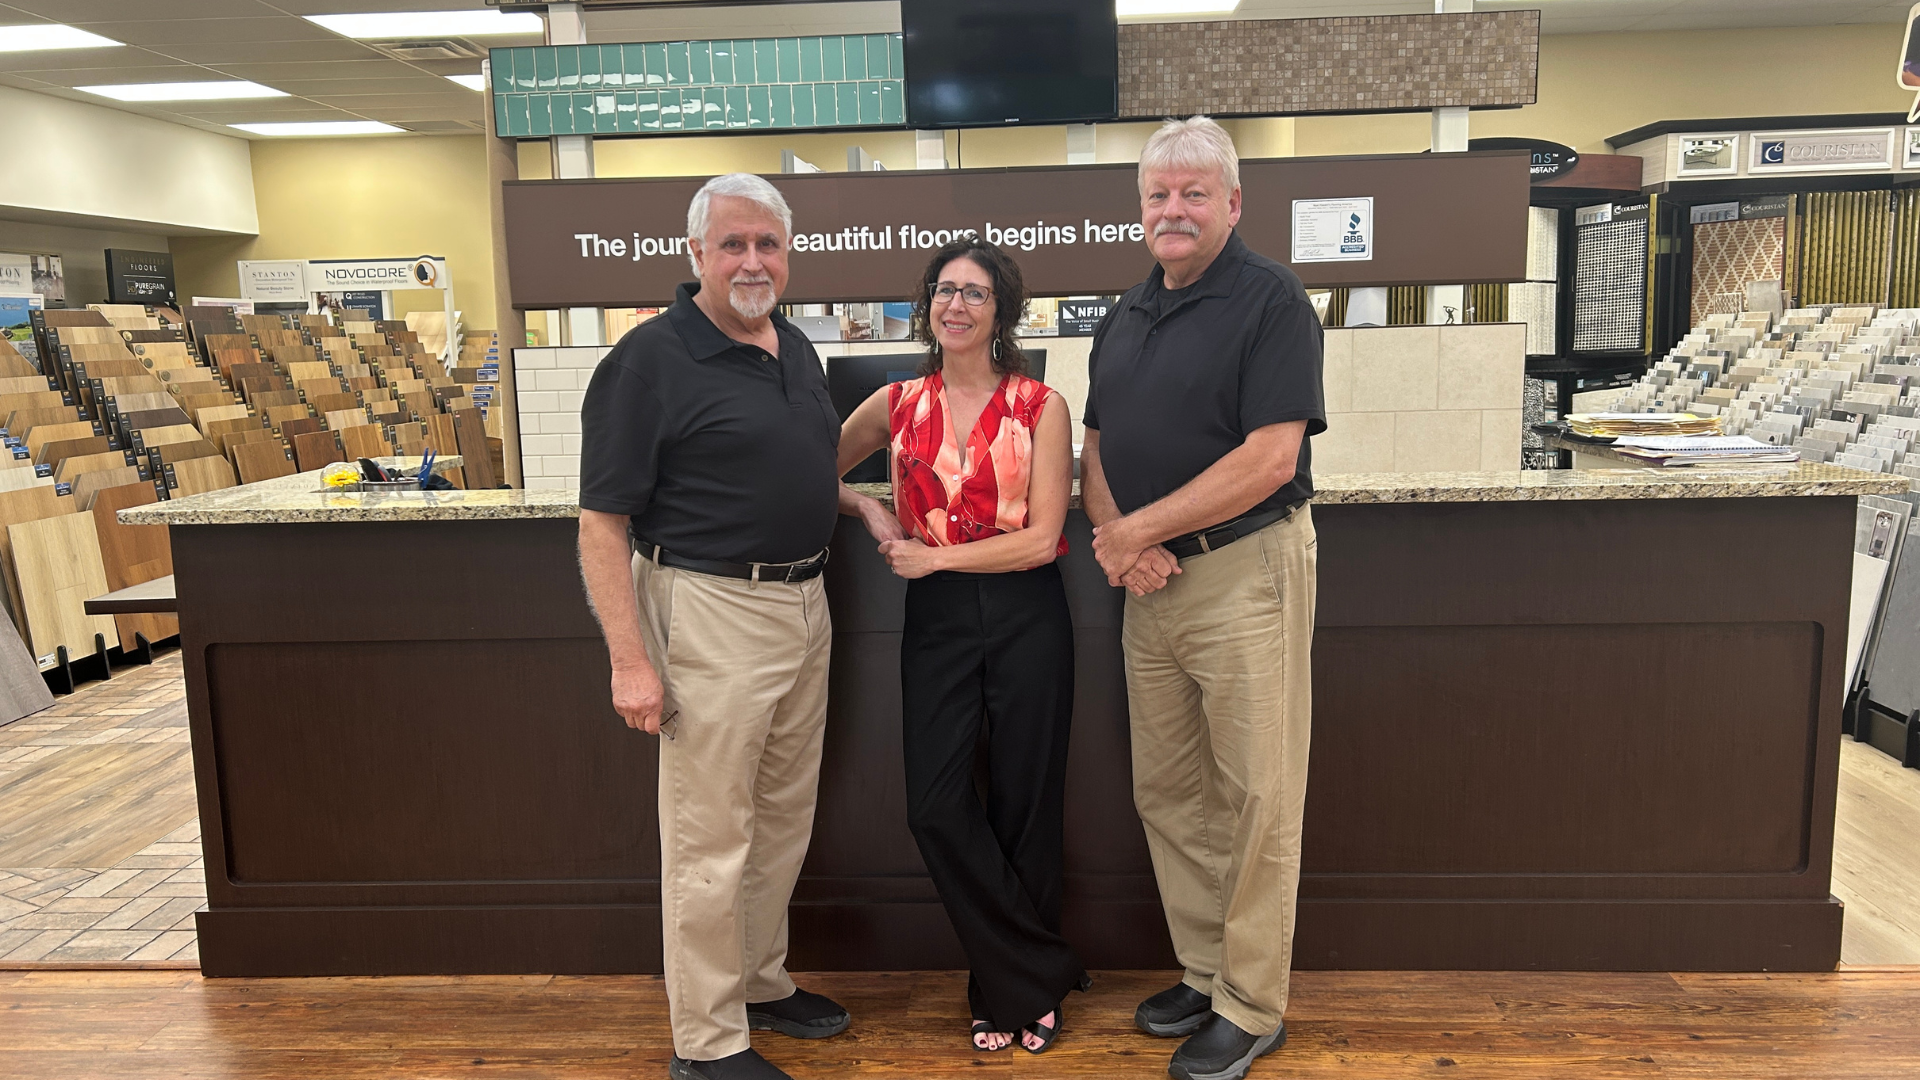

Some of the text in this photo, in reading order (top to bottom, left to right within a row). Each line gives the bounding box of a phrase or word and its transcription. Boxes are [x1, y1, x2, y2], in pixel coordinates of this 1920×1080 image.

[1790, 143, 1881, 158] COURISTAN
[1751, 203, 1787, 212] COURISTAN
[574, 233, 627, 258] The
[792, 225, 892, 252] eautiful
[986, 220, 1077, 251] begins
[1084, 219, 1145, 244] here
[130, 263, 157, 272] FLOORS
[135, 282, 165, 291] PUREGRAIN
[1077, 306, 1107, 317] NFIB
